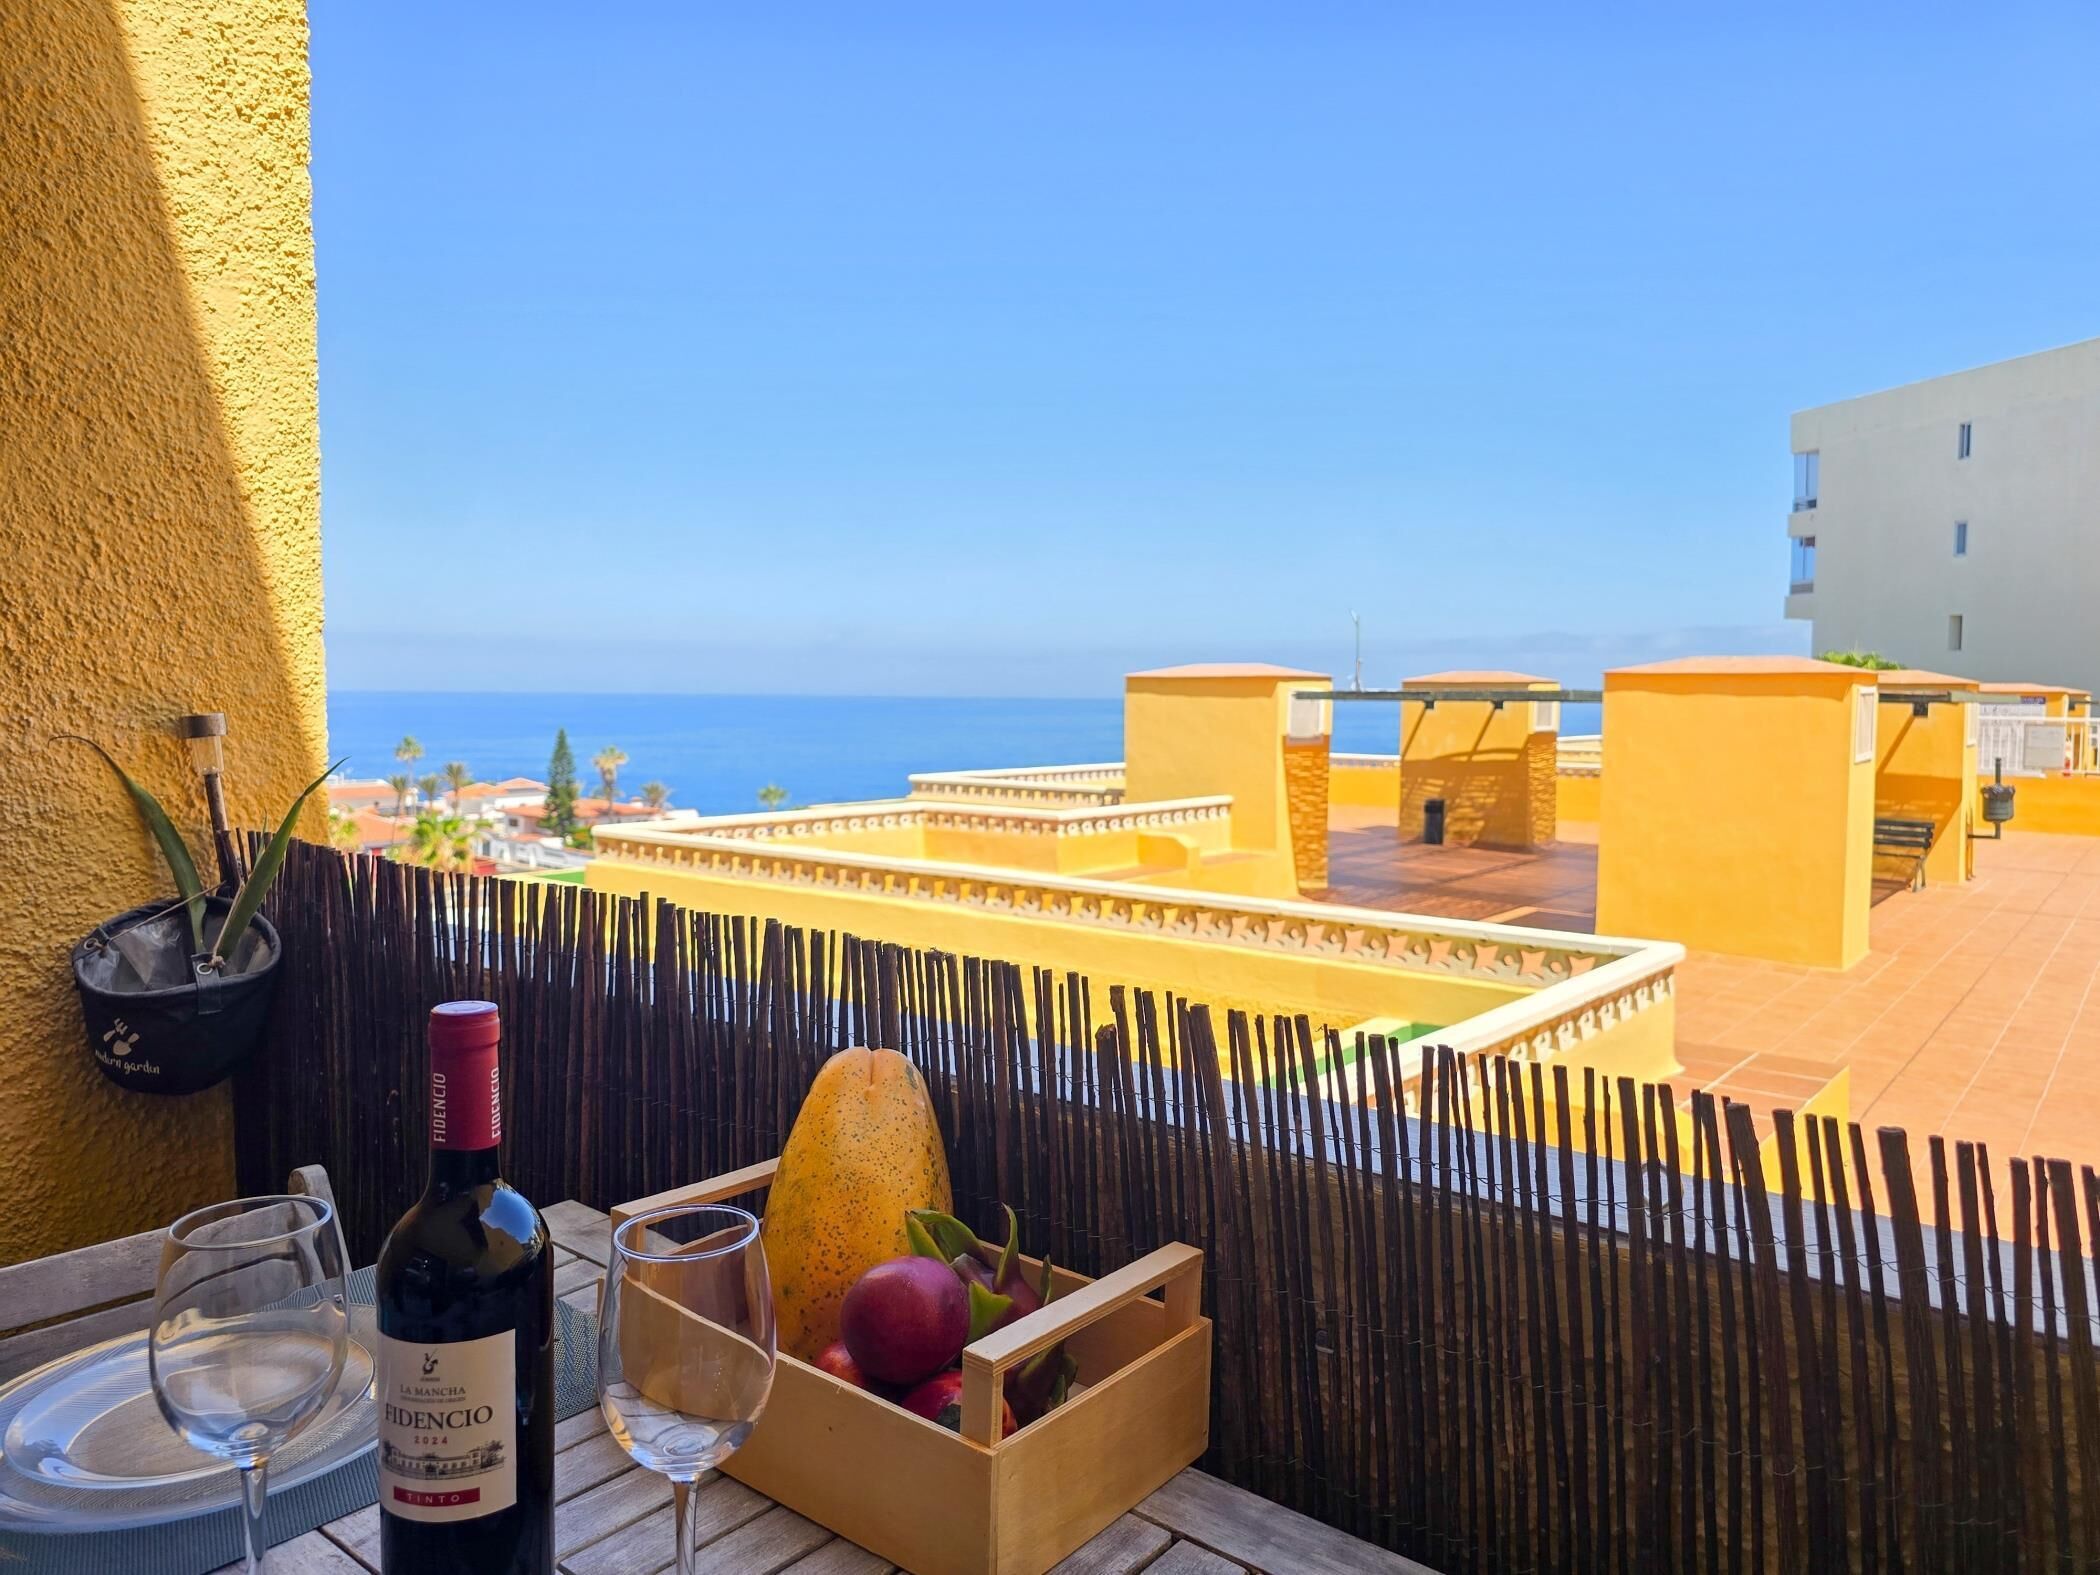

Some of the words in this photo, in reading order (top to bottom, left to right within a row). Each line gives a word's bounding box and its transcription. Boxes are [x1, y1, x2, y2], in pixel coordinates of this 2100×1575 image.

[124, 1059, 160, 1075] garden
[433, 1072, 446, 1143] FIDENCIO
[490, 1066, 502, 1139] FIDENCIO
[400, 1383, 412, 1395] LA
[414, 1386, 467, 1397] MANCHA
[385, 1402, 494, 1430] FIDENCIO
[414, 1435, 448, 1446] 2024
[407, 1493, 460, 1504] TINTO
